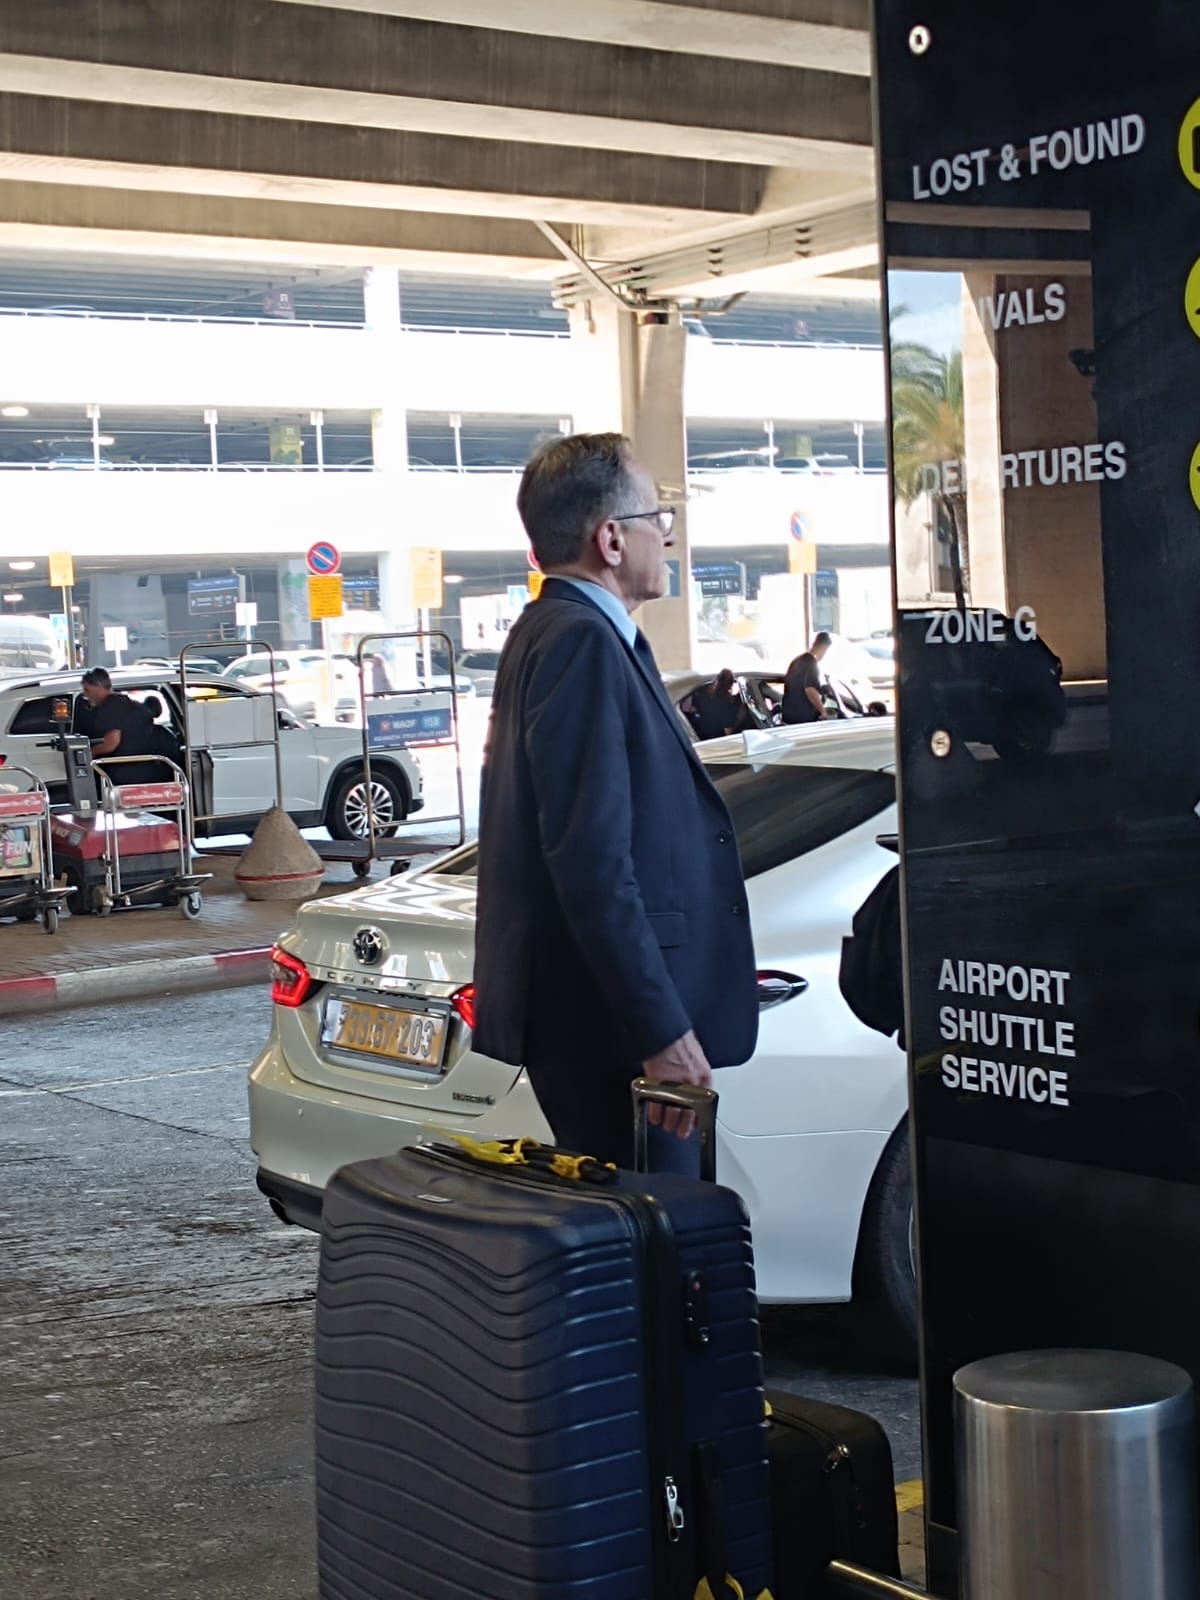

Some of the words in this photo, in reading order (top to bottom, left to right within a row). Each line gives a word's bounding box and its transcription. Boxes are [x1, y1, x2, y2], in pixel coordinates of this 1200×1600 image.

[912, 149, 991, 200] LOST
[999, 143, 1021, 182] &
[1029, 113, 1146, 176] FOUND
[921, 441, 1128, 495] DERTURES
[924, 608, 1007, 644] ZONE
[1014, 605, 1038, 642] G
[938, 958, 1071, 1006] AIRPORT
[939, 1006, 1077, 1058] SHUTTLE
[941, 1054, 1070, 1106] SERVICE
